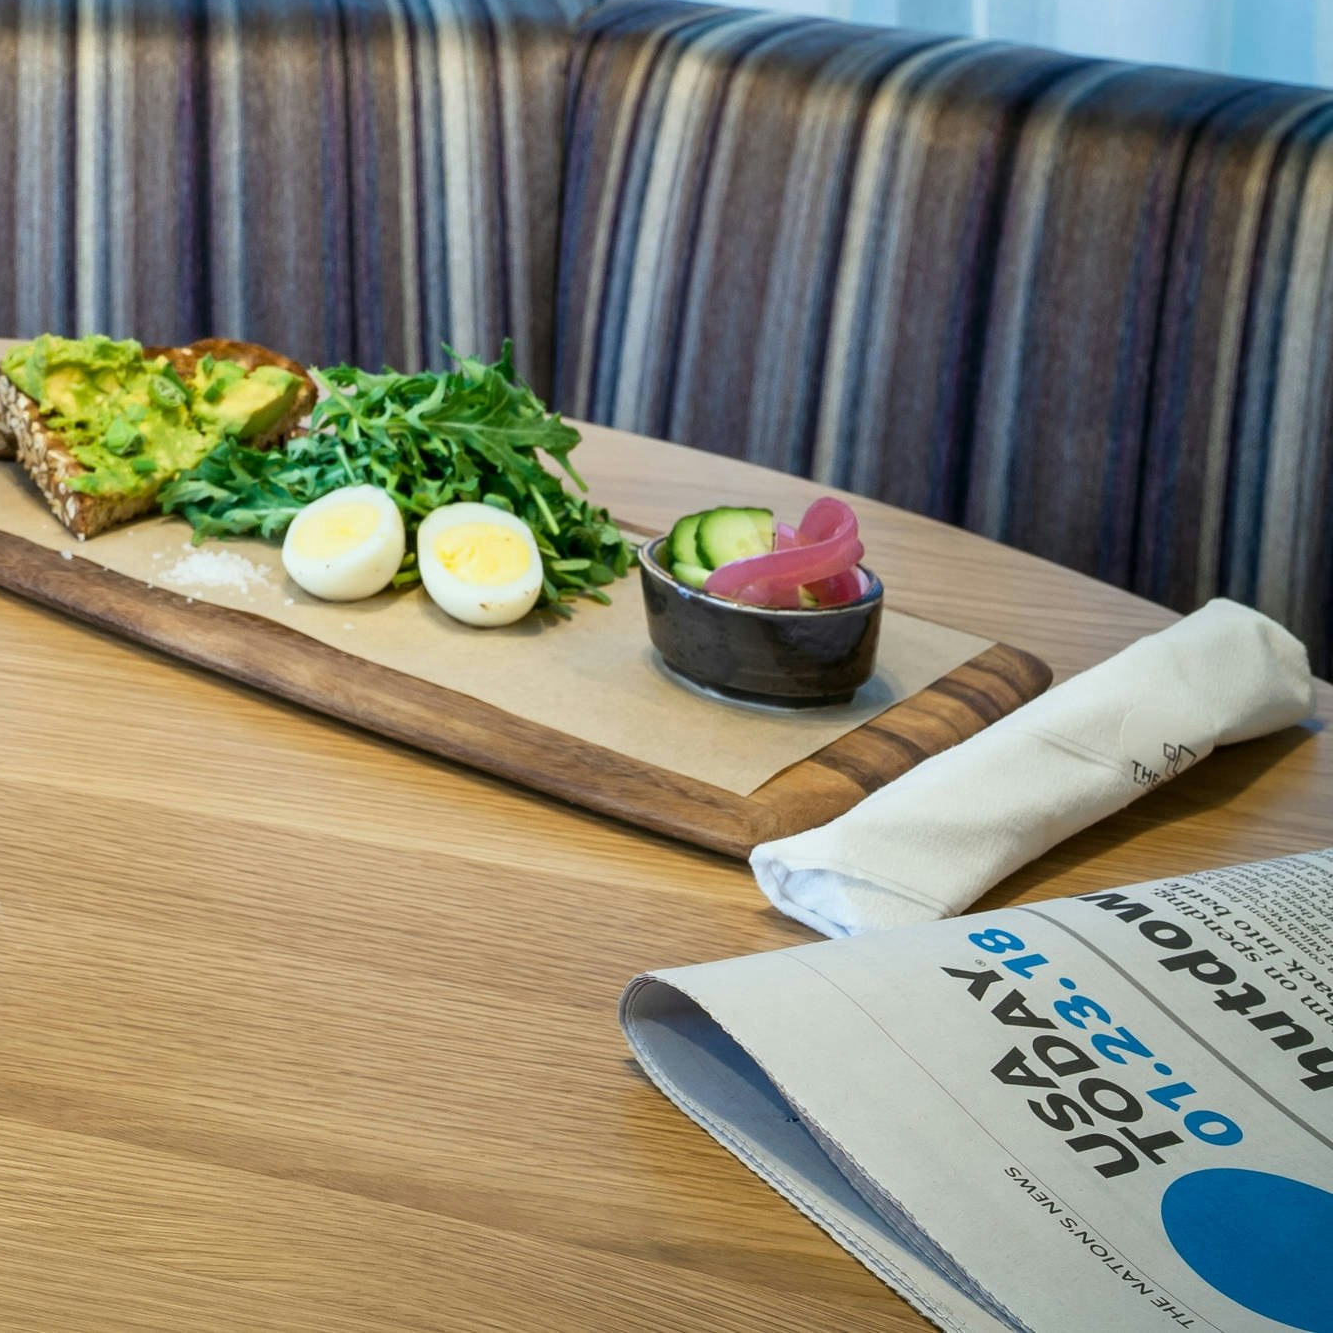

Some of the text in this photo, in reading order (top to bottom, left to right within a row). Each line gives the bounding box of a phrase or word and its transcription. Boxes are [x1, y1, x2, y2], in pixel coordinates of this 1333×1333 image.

[1163, 882, 1232, 917] battle
[1234, 920, 1285, 956] into
[1243, 904, 1325, 965] commitment
[1287, 922, 1326, 952] Mitch
[1264, 966, 1298, 991] on
[940, 966, 1185, 1166] TODAY
[968, 928, 1244, 1146] 01.23.18
[990, 1046, 1140, 1179] USA
[1004, 1166, 1195, 1330] THE NATION'S NEWS
